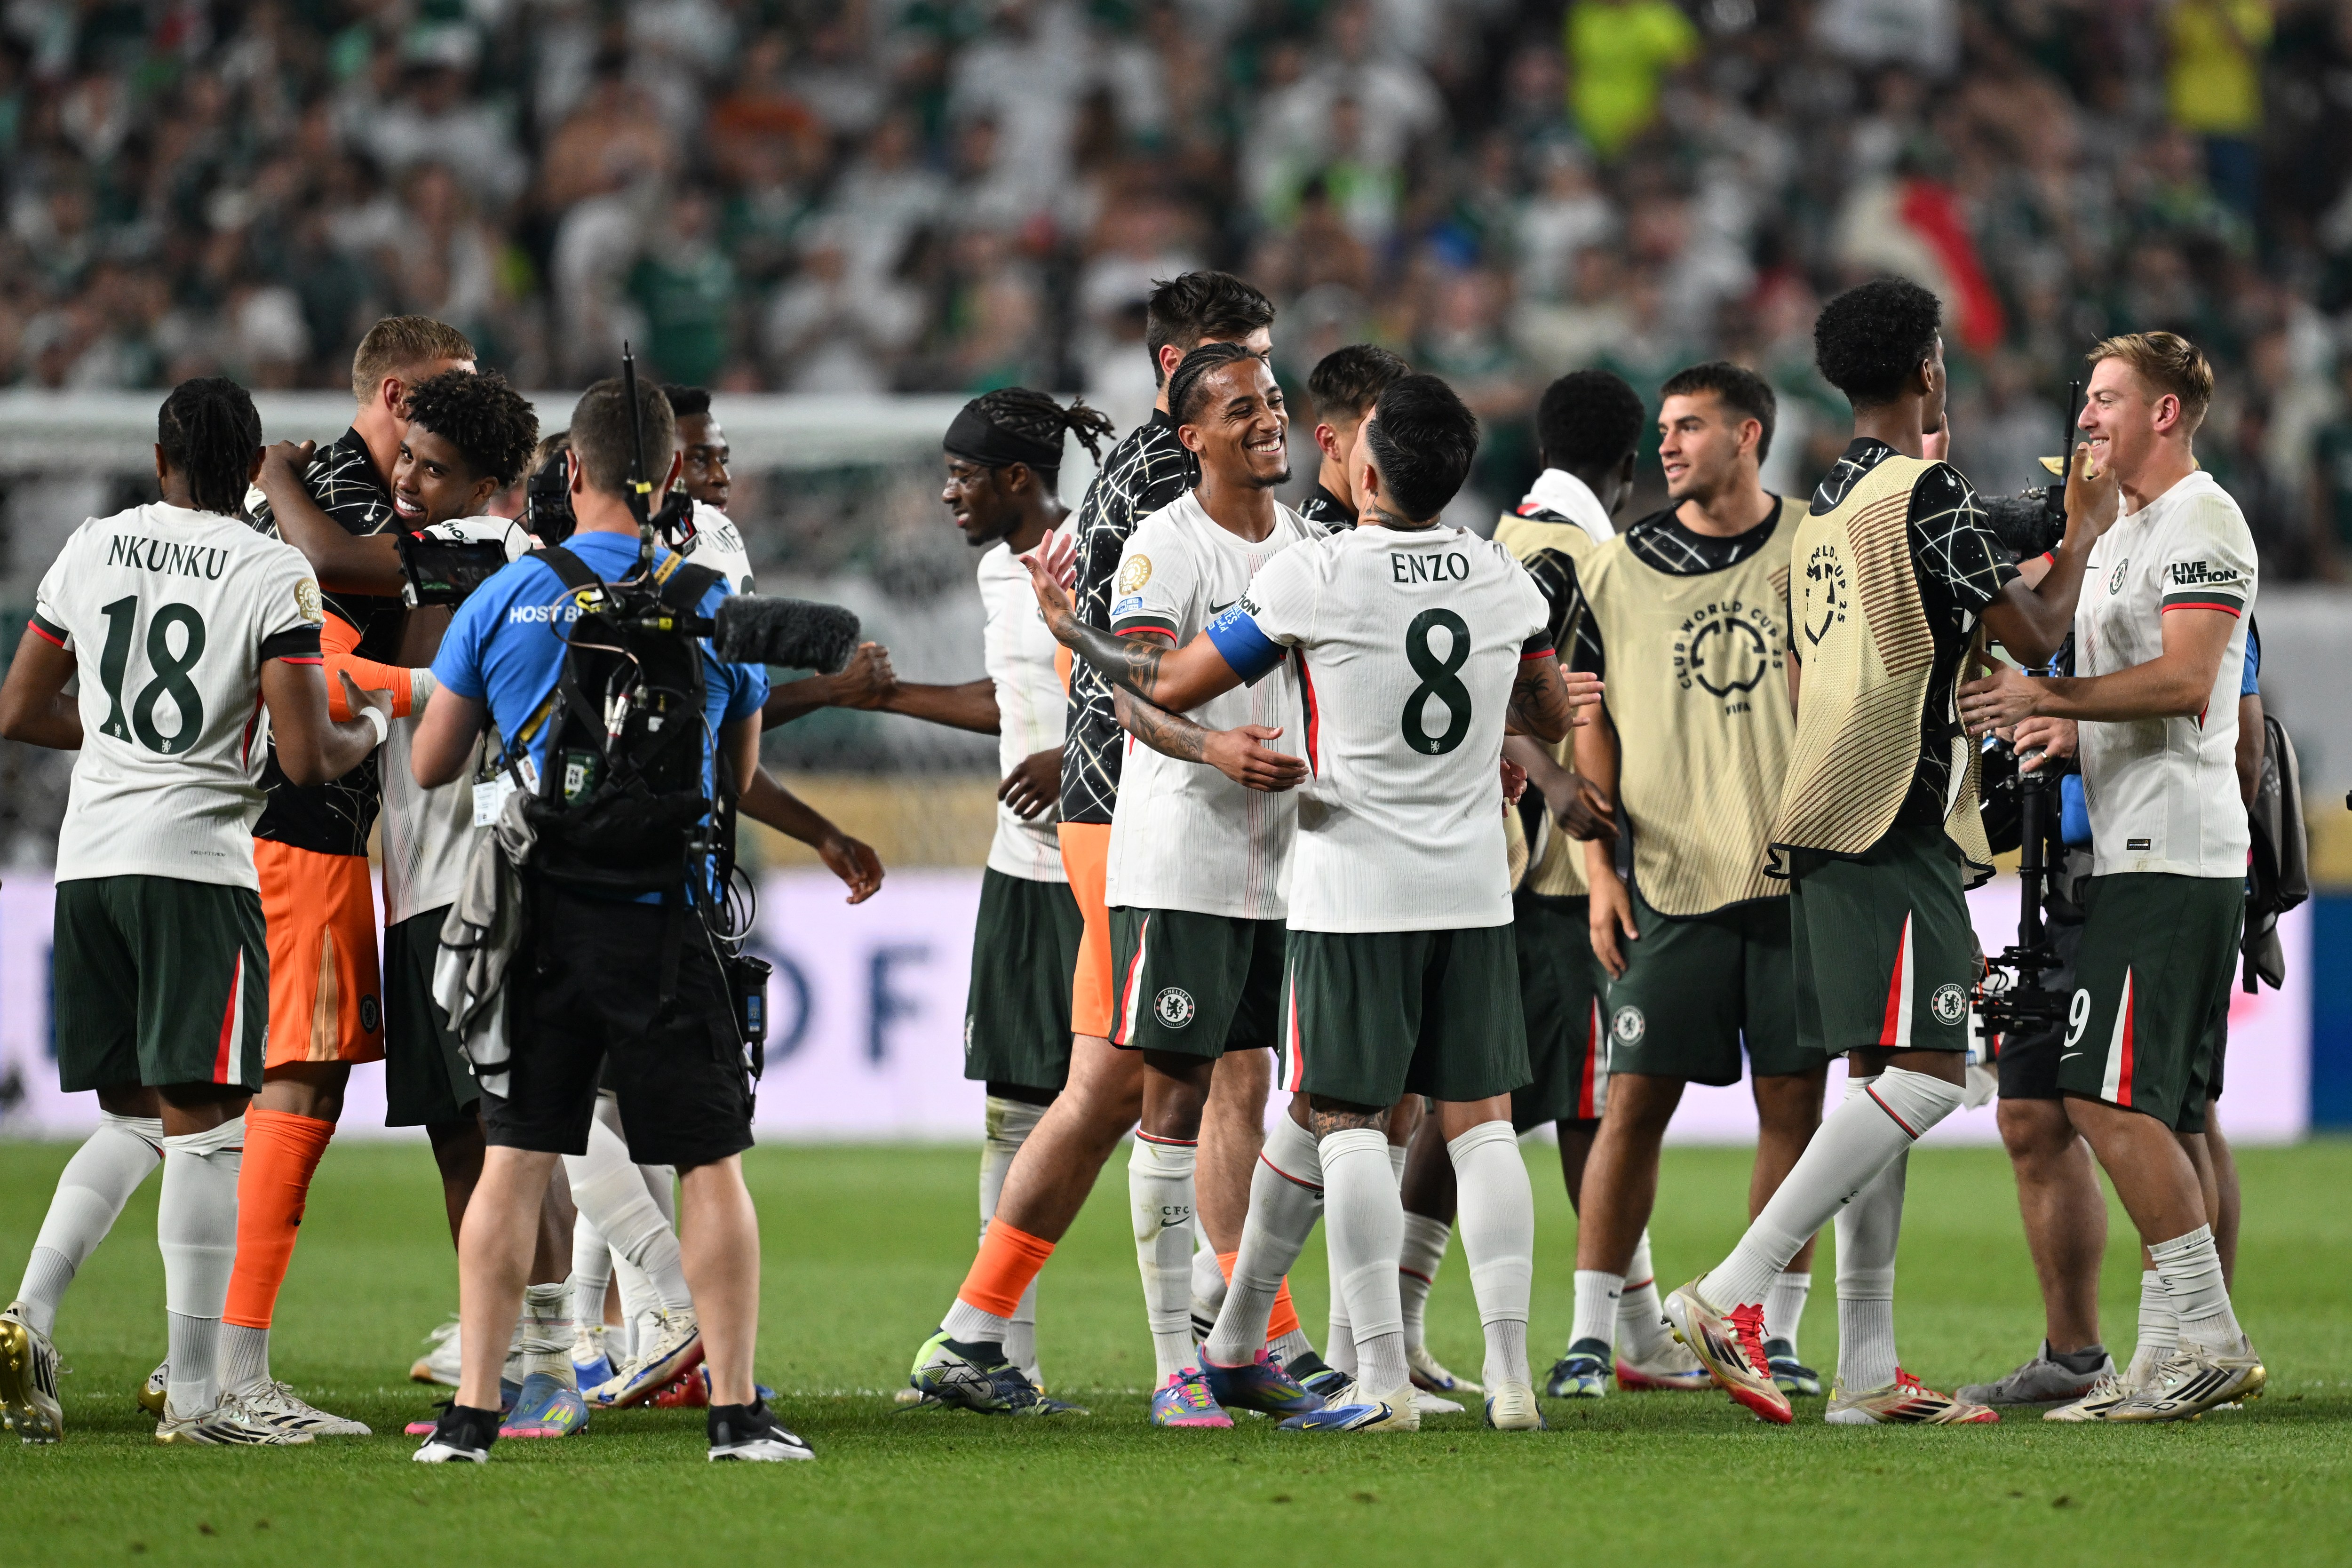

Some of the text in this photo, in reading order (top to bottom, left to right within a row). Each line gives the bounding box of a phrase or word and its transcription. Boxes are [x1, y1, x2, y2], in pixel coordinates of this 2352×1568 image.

[107, 535, 228, 581] NKUNKU
[1391, 552, 1470, 583] ENZO
[2172, 561, 2207, 575] LIVE
[2173, 570, 2238, 585] NATION
[509, 605, 562, 624] HOST
[1237, 594, 1262, 616] TION
[1837, 600, 1847, 623] 25
[1673, 601, 1783, 690] CLUB WORLD CUP 25
[99, 595, 206, 755] 18
[1401, 608, 1472, 756] 8
[1725, 701, 1751, 716] FIFA
[1163, 989, 1189, 1001] CHELSEA
[1939, 986, 1963, 995] CHELSEA
[1159, 1015, 1175, 1026] FOOTBALL
[2064, 988, 2091, 1047] 9
[1163, 1206, 1190, 1215] CFC
